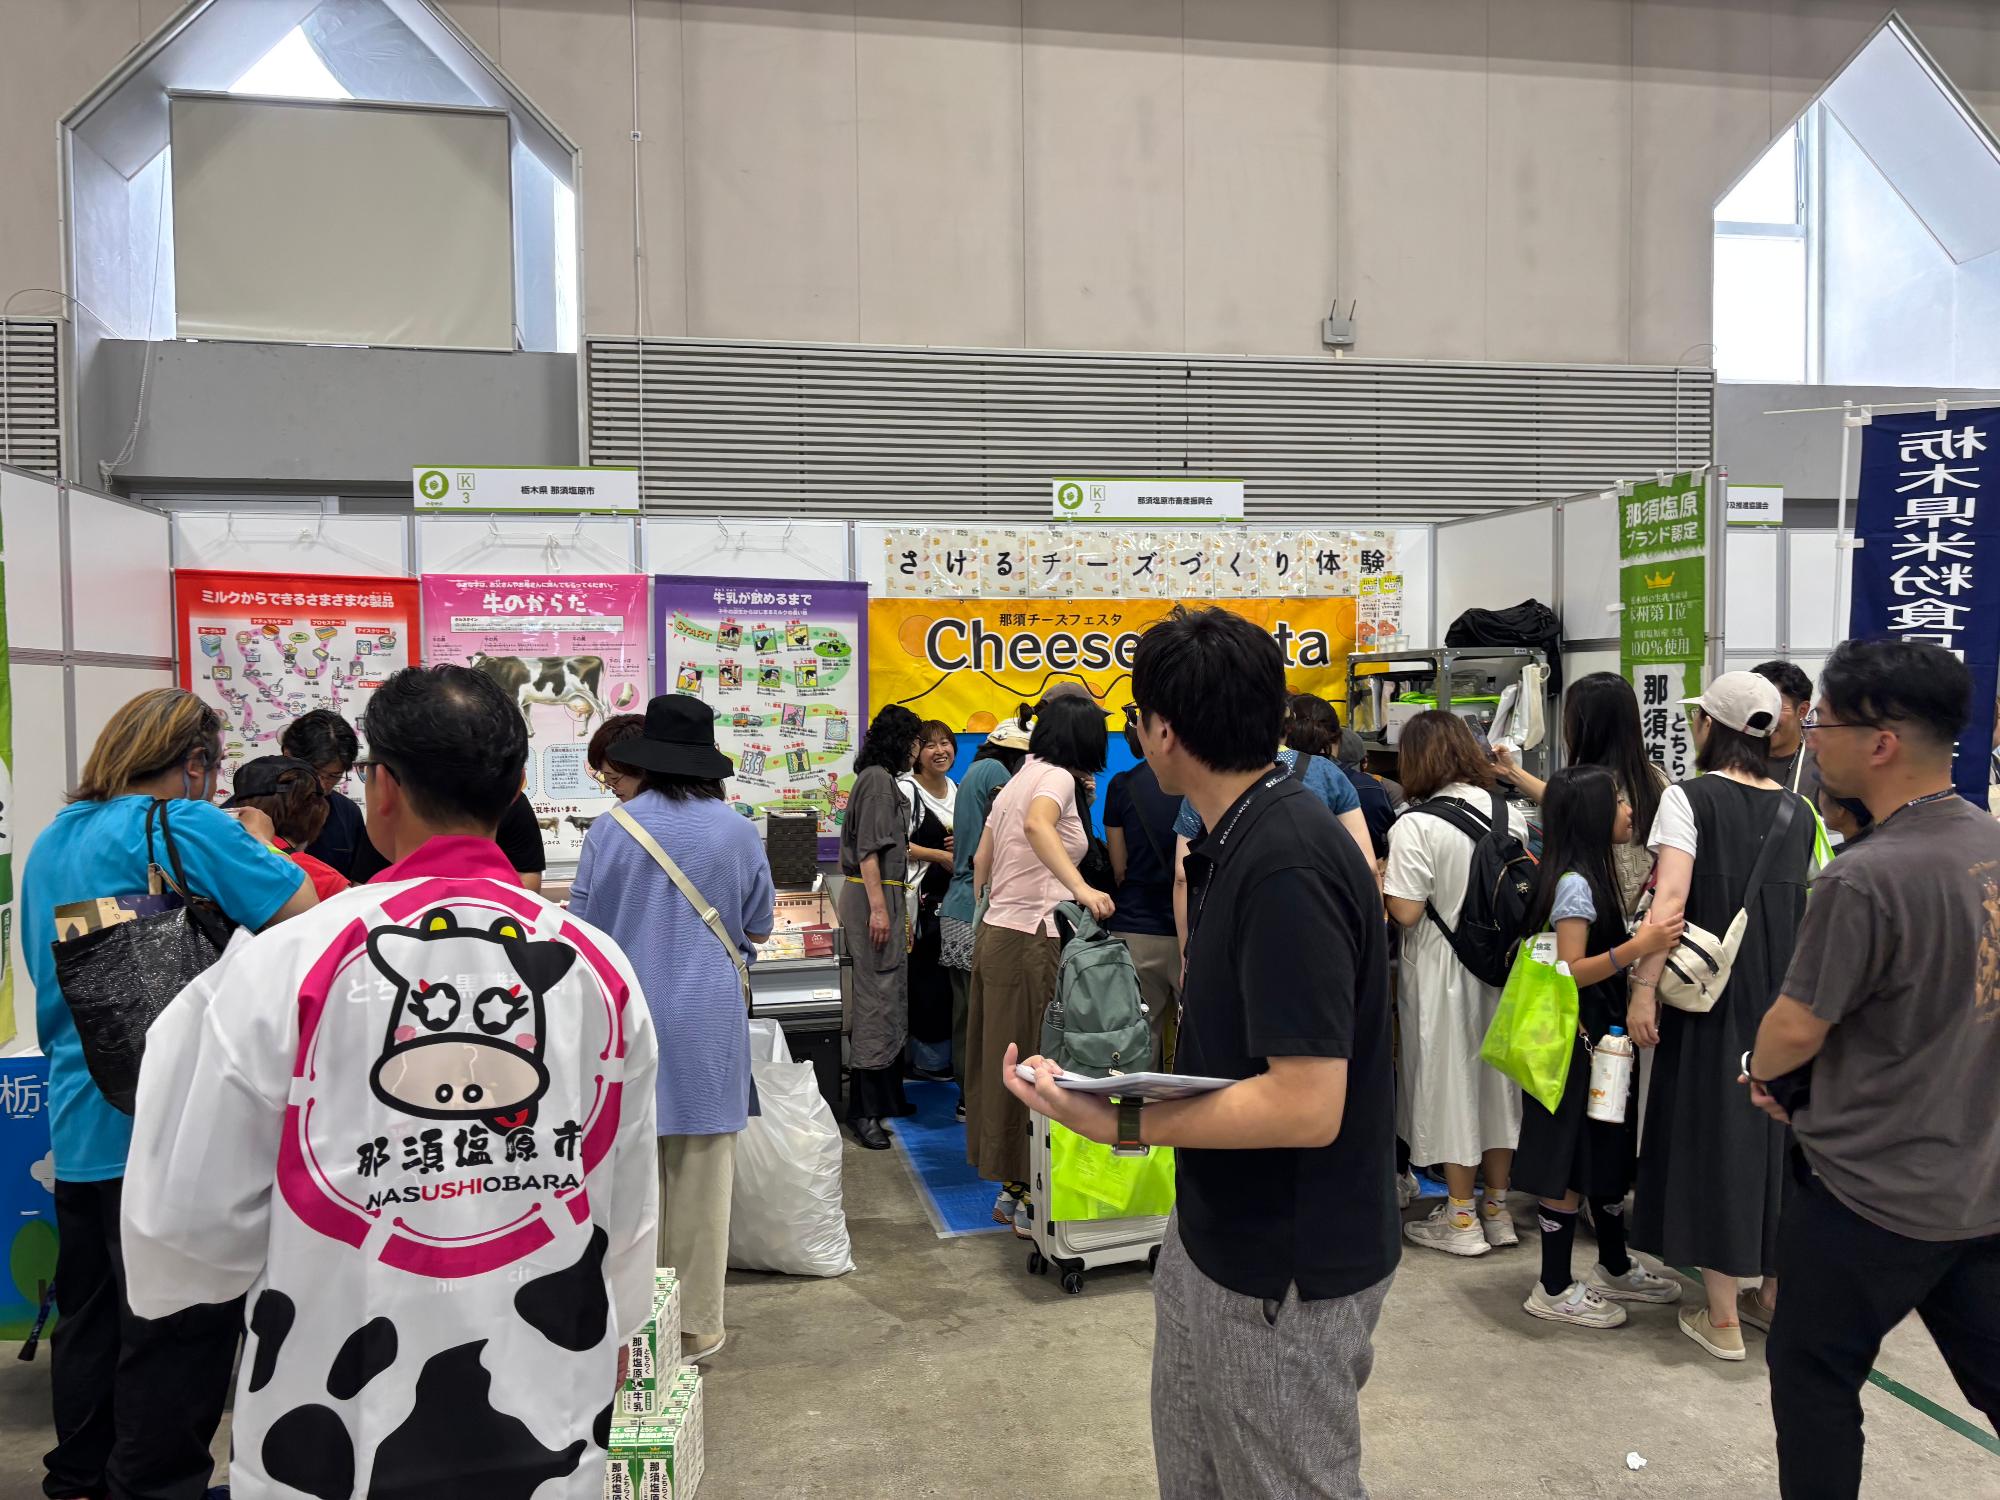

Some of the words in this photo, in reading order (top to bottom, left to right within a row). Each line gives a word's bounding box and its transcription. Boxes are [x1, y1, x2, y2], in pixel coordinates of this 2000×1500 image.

[461, 475, 472, 488] K
[521, 485, 548, 495] 栃木県
[550, 486, 595, 496] 那須塩原市
[462, 492, 471, 504] 3
[1093, 487, 1102, 499] K
[1093, 502, 1101, 514] 2
[1625, 490, 1699, 529] 那須塩原
[1626, 521, 1699, 549] ブランド認定
[201, 589, 395, 608] ミルクからできるさまざまな製品
[482, 592, 589, 614] 牛のからだ
[713, 591, 813, 606] 牛乳が飲めるまで
[999, 612, 1123, 627] 那須チーズフェスタ
[676, 620, 713, 641] START
[925, 616, 1142, 672] Cheese
[1273, 619, 1331, 669] ta
[1670, 712, 1688, 782] とちら
[356, 1119, 585, 1179] 那須塩原市
[364, 1172, 582, 1211] NASUSHIOBARA
